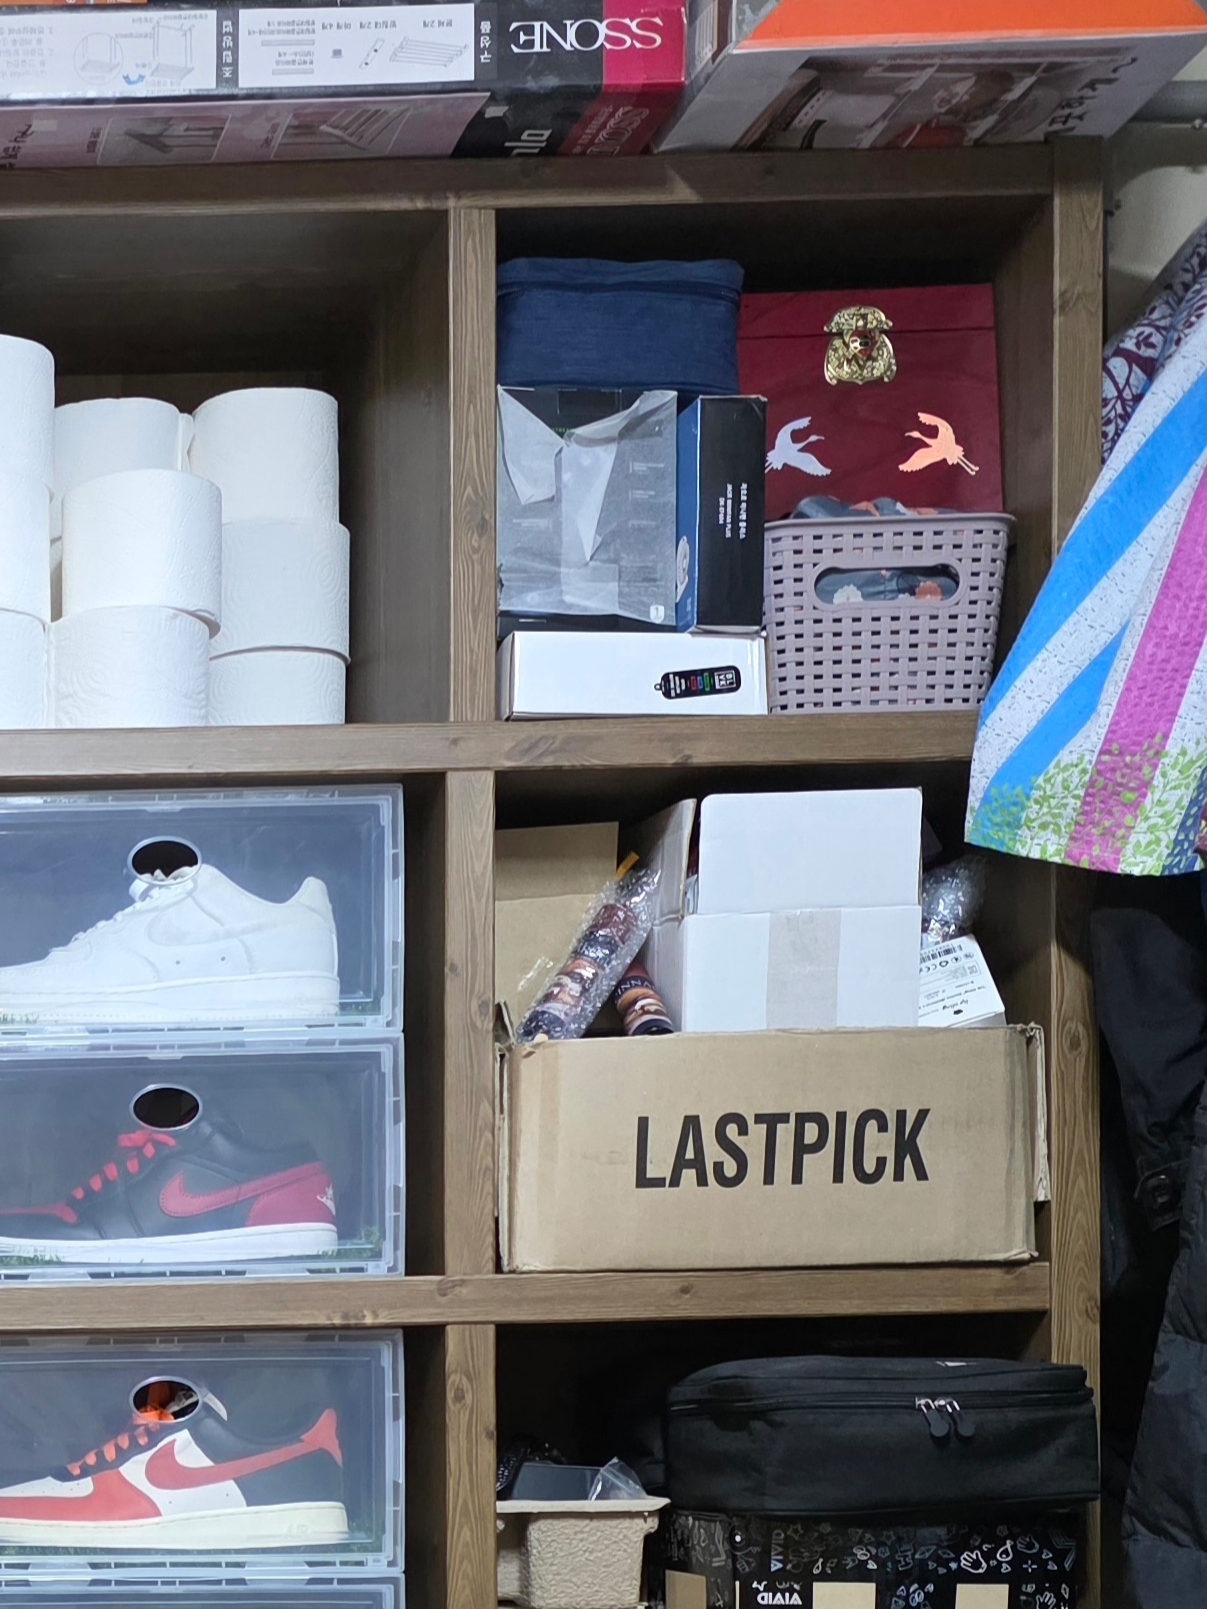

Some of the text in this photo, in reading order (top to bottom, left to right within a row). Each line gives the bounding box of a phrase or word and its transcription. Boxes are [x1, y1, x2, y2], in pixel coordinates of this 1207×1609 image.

[509, 16, 664, 53] SSONE
[634, 1108, 931, 1189] LASTPICK
[770, 1529, 784, 1572] VIVID
[757, 1592, 802, 1605] VIVID
